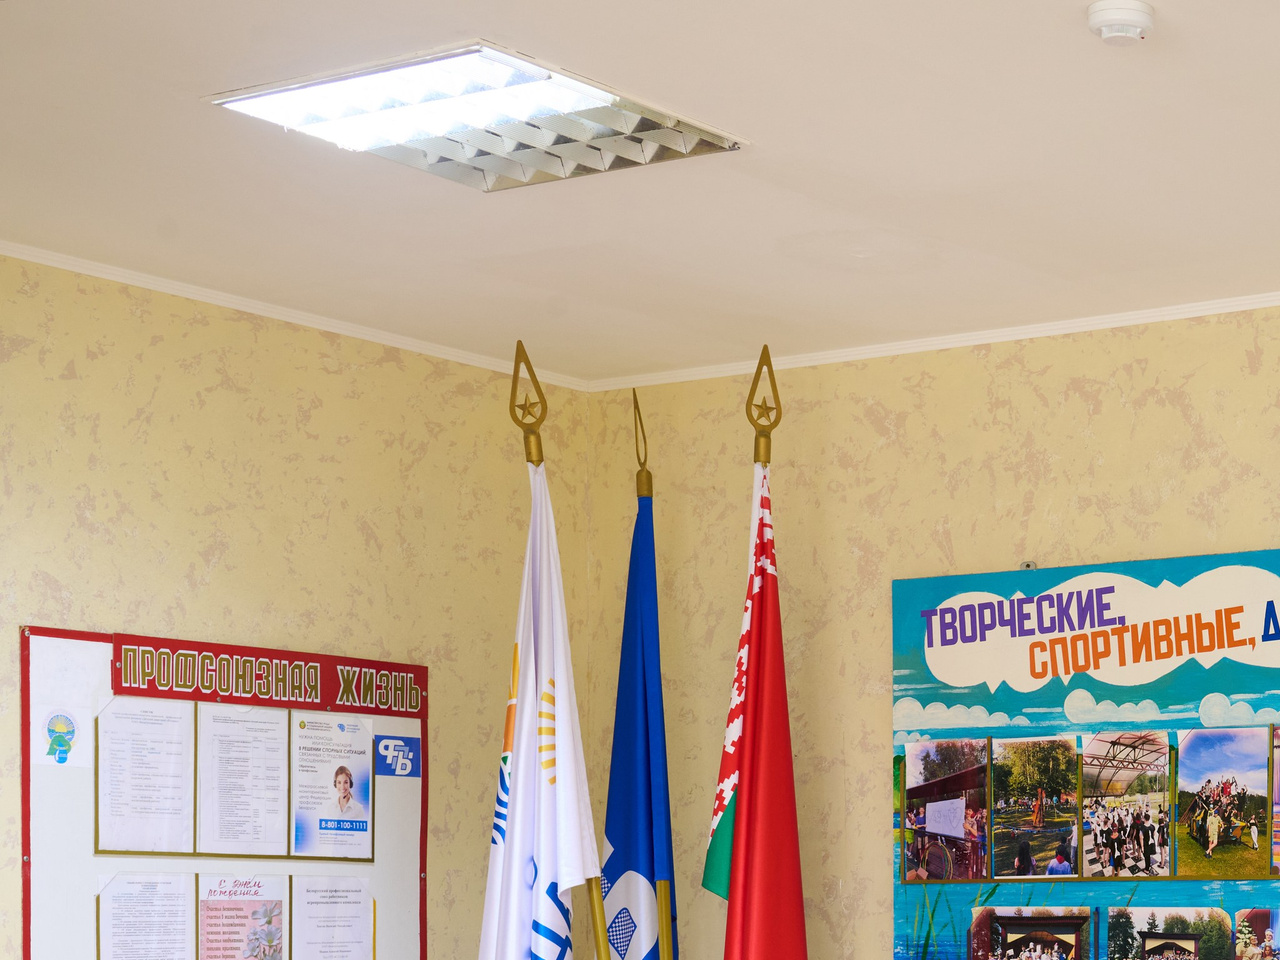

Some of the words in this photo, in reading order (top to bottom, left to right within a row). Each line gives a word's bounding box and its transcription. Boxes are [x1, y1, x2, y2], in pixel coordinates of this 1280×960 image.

[921, 585, 1126, 649] ТВОРЧЕСКИЕ,
[1028, 605, 1257, 680] СПОРТИВНЫЕ,
[121, 645, 321, 703] ПРОФСОЮЗНАЯ
[335, 664, 422, 713] ЖИЗНЬ
[321, 820, 367, 830] 8-801-100-1111
